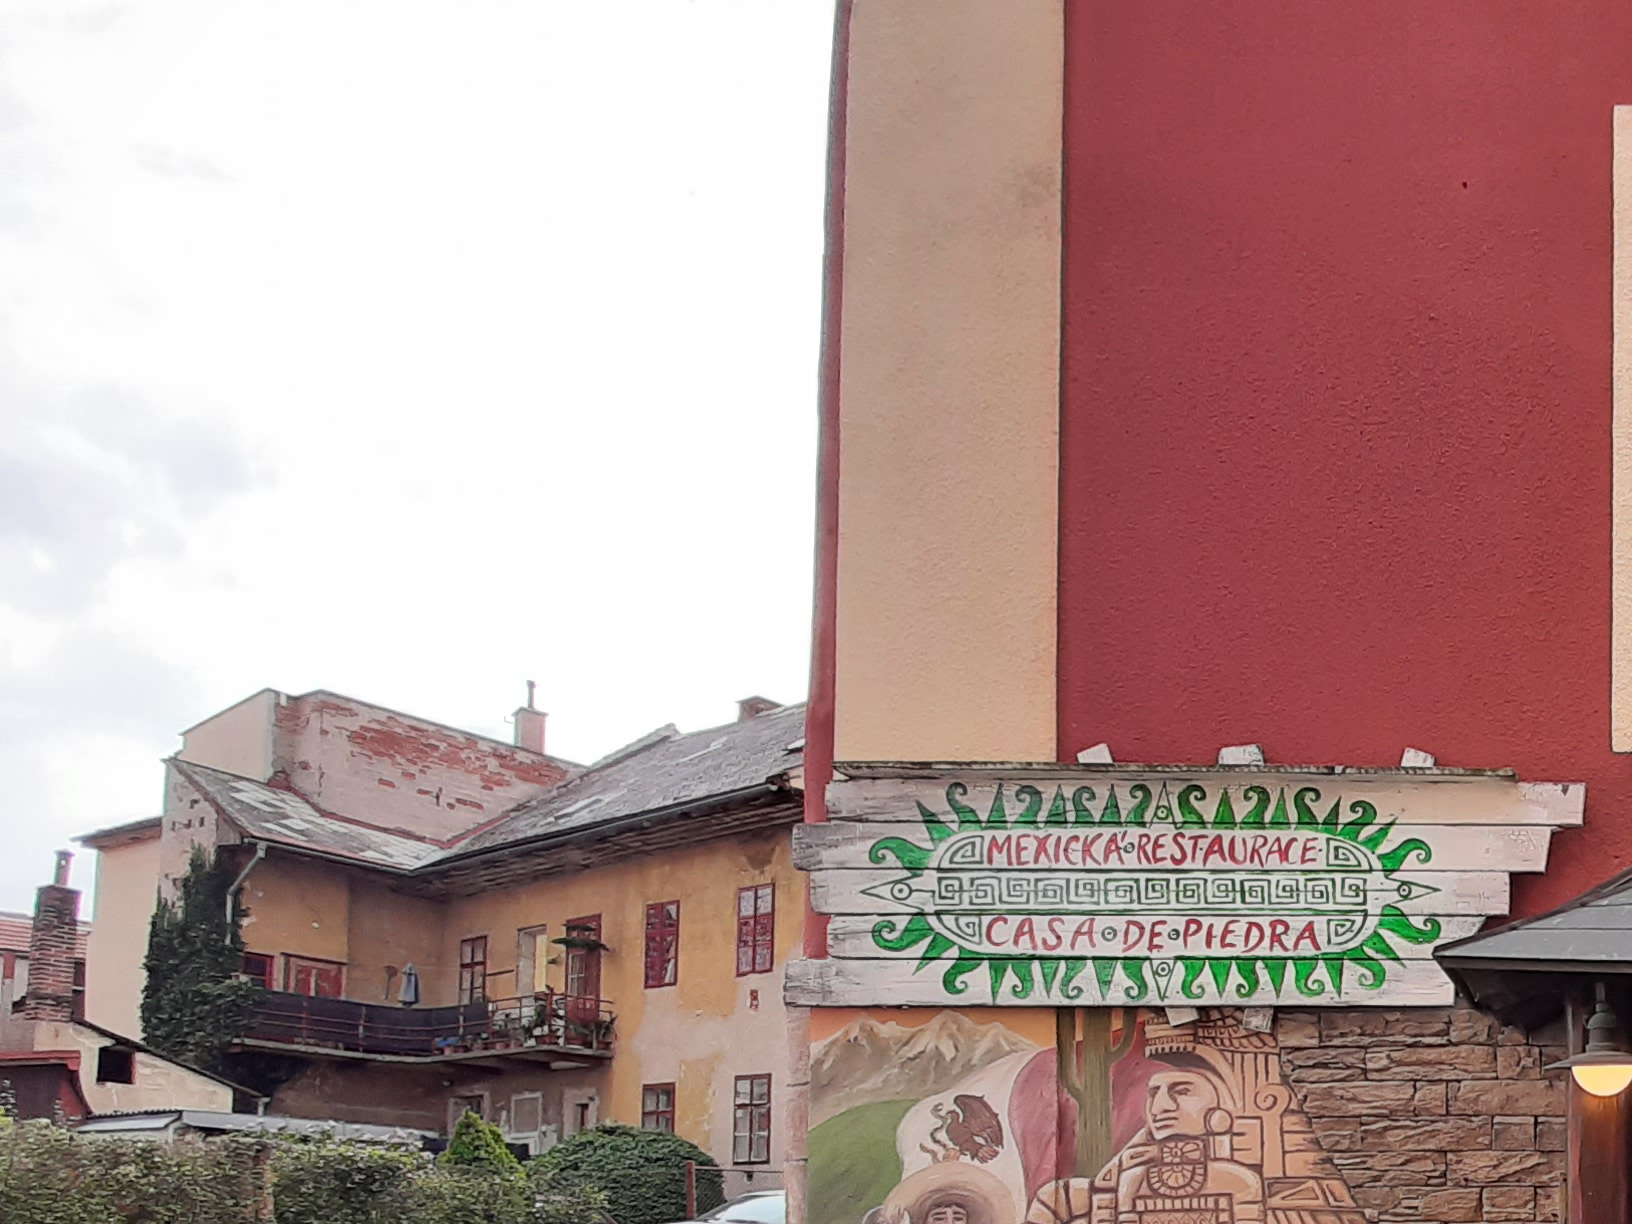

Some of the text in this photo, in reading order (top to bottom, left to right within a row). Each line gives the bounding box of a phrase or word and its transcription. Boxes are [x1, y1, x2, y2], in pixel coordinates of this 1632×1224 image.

[1137, 832, 1319, 868] RESTAURACE
[986, 914, 1322, 954] CASA DE PIEDRA
